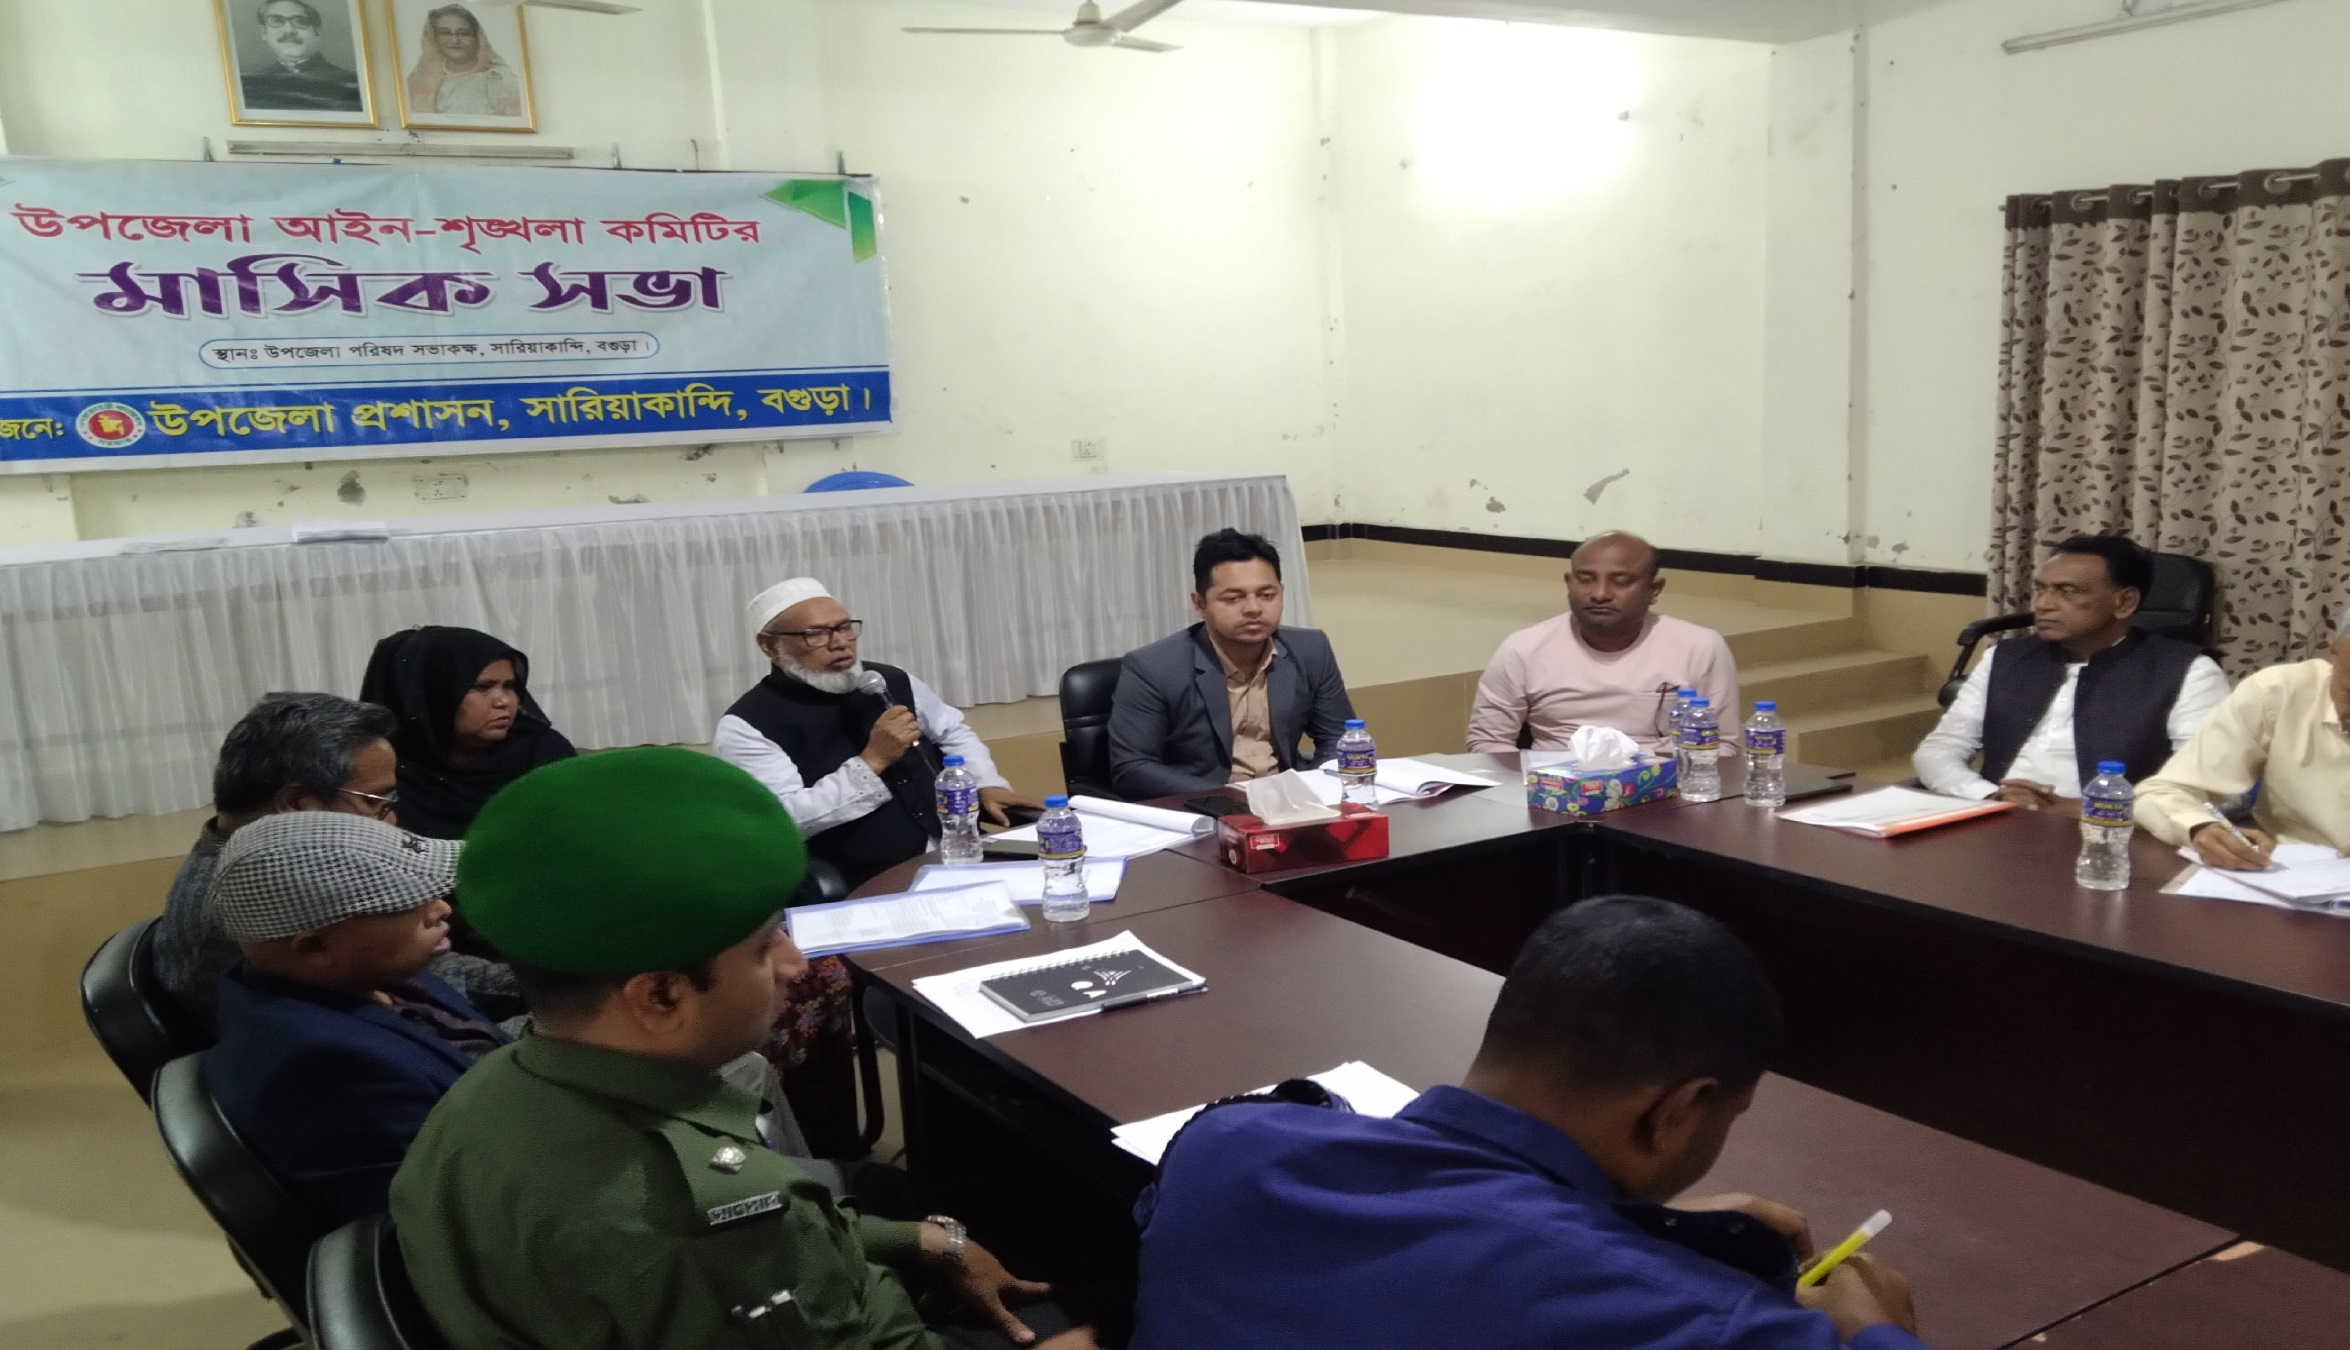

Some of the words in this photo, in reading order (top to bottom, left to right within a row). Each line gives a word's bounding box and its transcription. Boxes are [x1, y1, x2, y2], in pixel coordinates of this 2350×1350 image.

[10, 202, 254, 245] উপজেলা
[602, 211, 761, 246] কমিটির
[74, 253, 493, 318] মাসিক
[517, 261, 729, 313] সভা
[264, 344, 341, 359] উপজেলা
[349, 342, 404, 357] পরিষদ
[411, 342, 484, 356] সভাকক্ষ,
[490, 339, 590, 355] সারিয়াকান্দি,
[146, 401, 335, 438] উপজেলা
[352, 398, 510, 433] প্রশাসন,
[520, 382, 748, 424] সারিয়াকান্দি,
